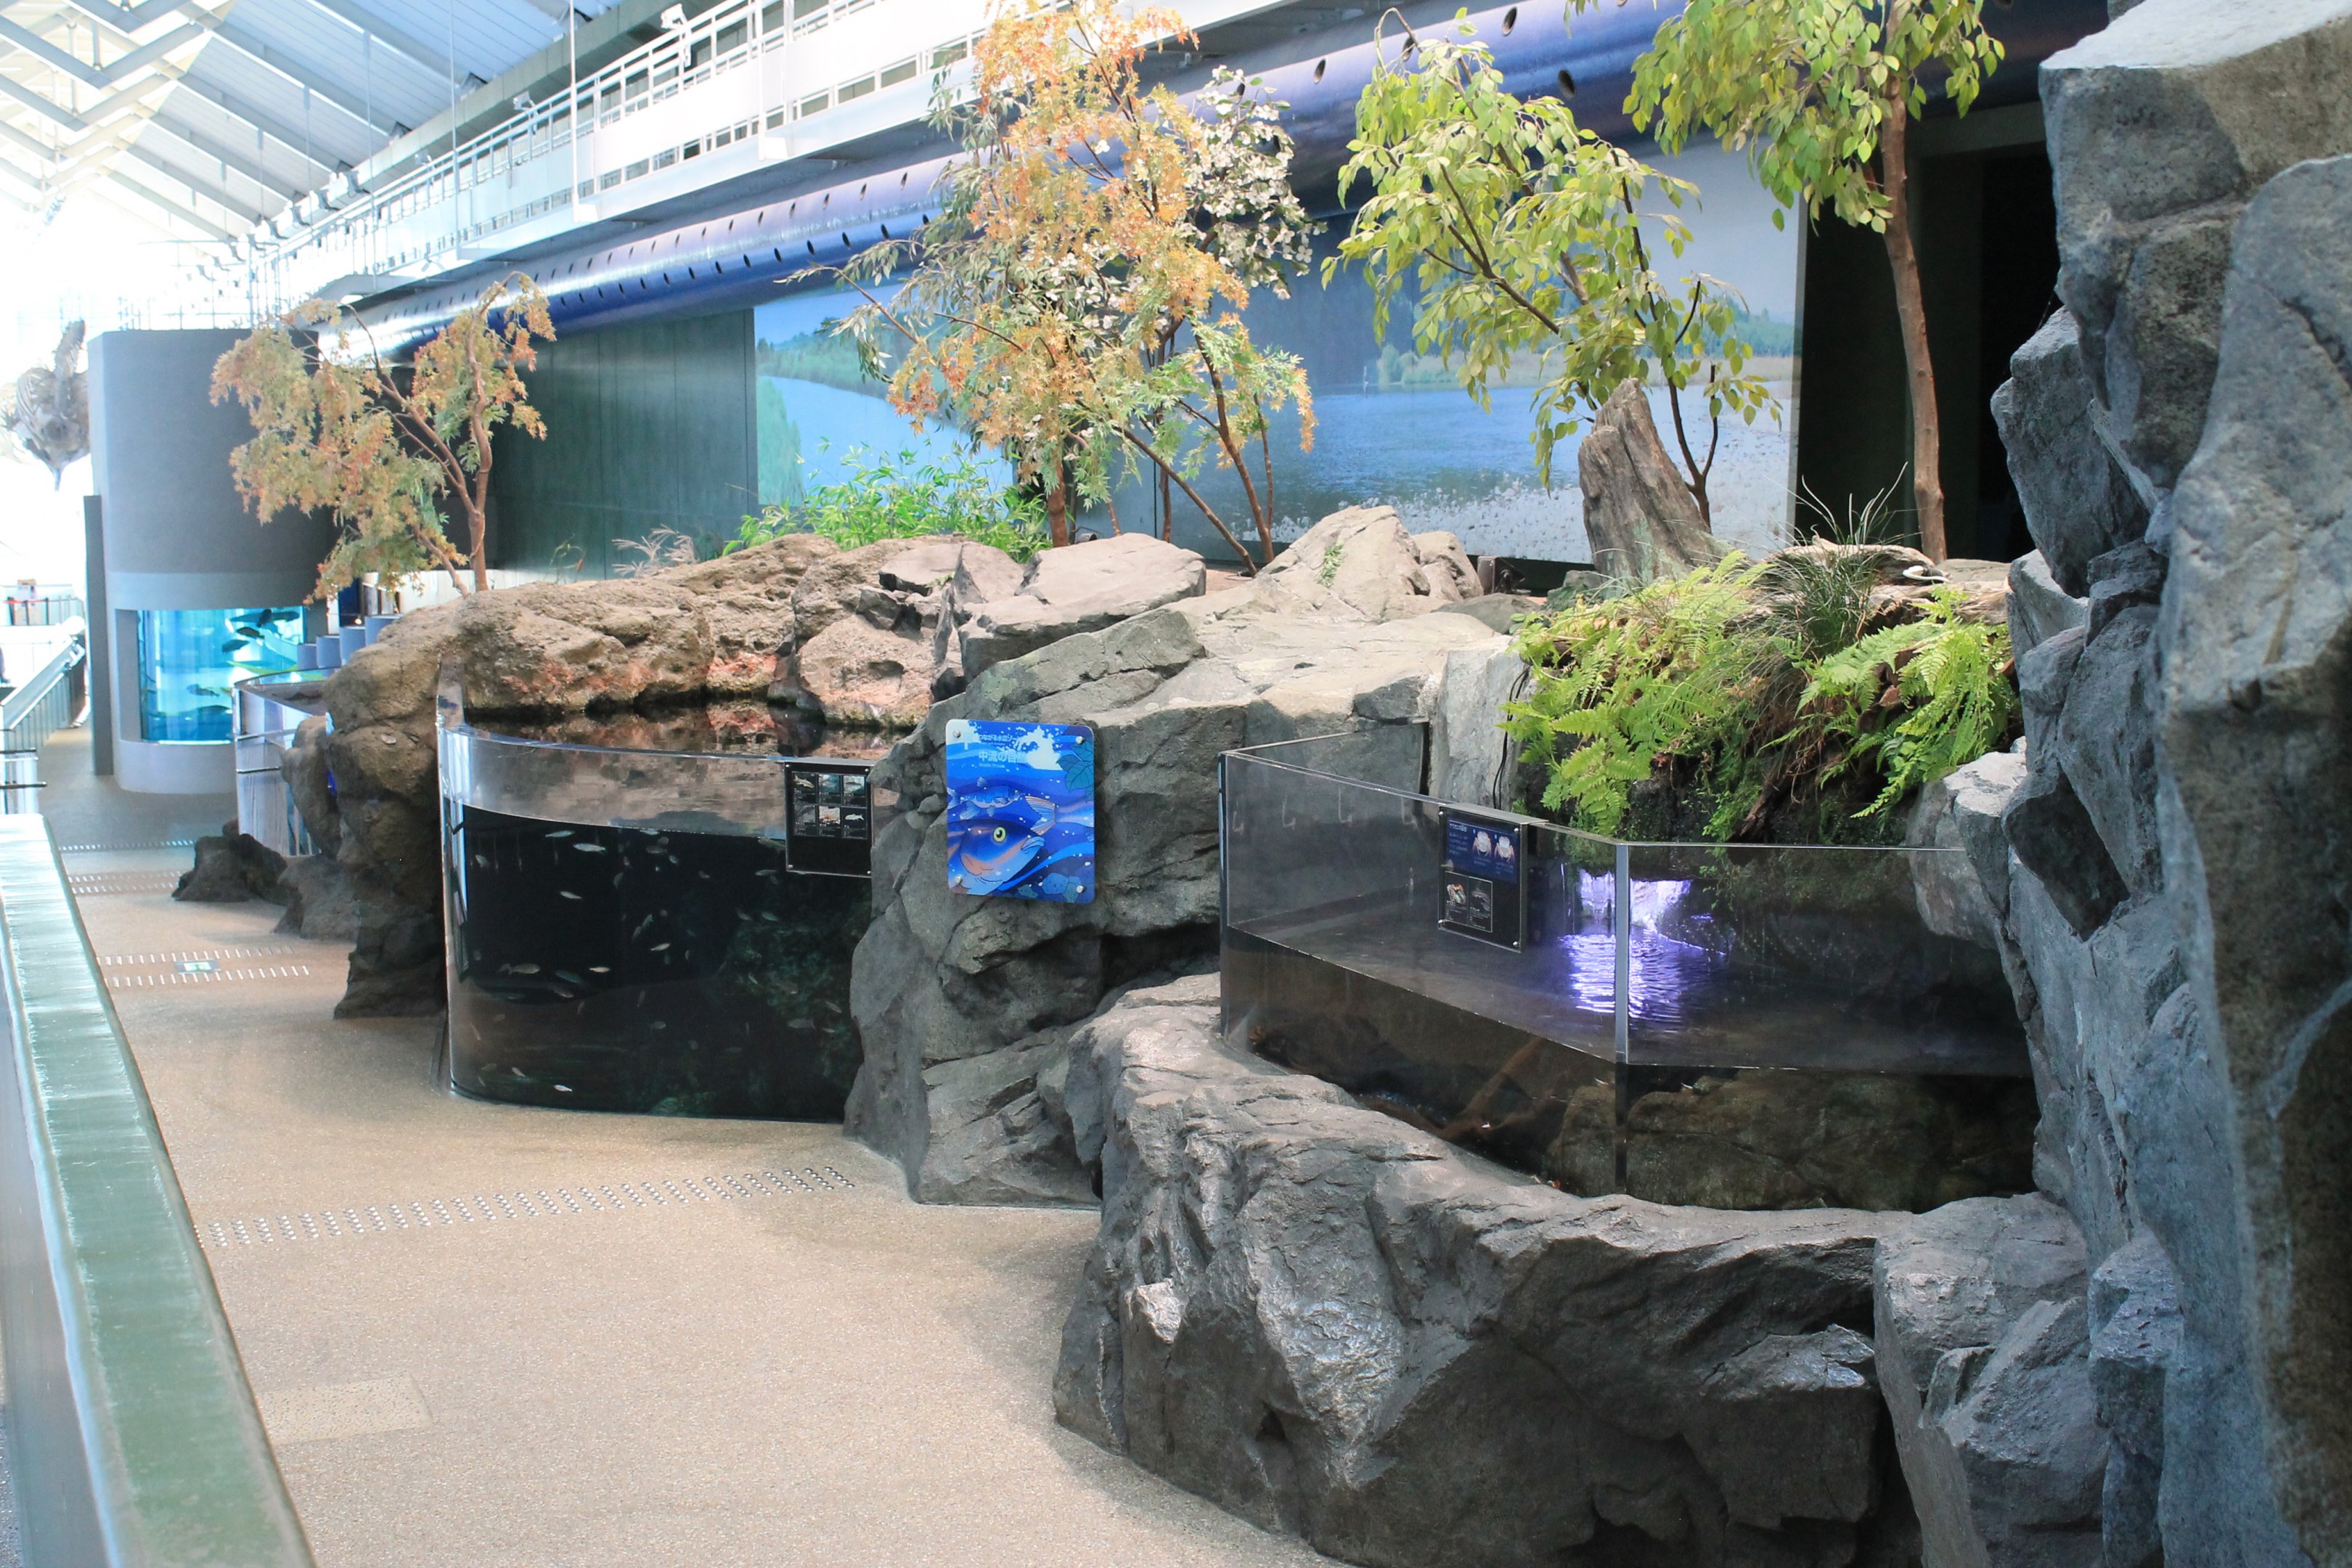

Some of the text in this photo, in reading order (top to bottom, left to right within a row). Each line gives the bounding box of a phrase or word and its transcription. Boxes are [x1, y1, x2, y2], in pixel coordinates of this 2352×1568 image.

[979, 751, 1027, 764] 中流の自然
